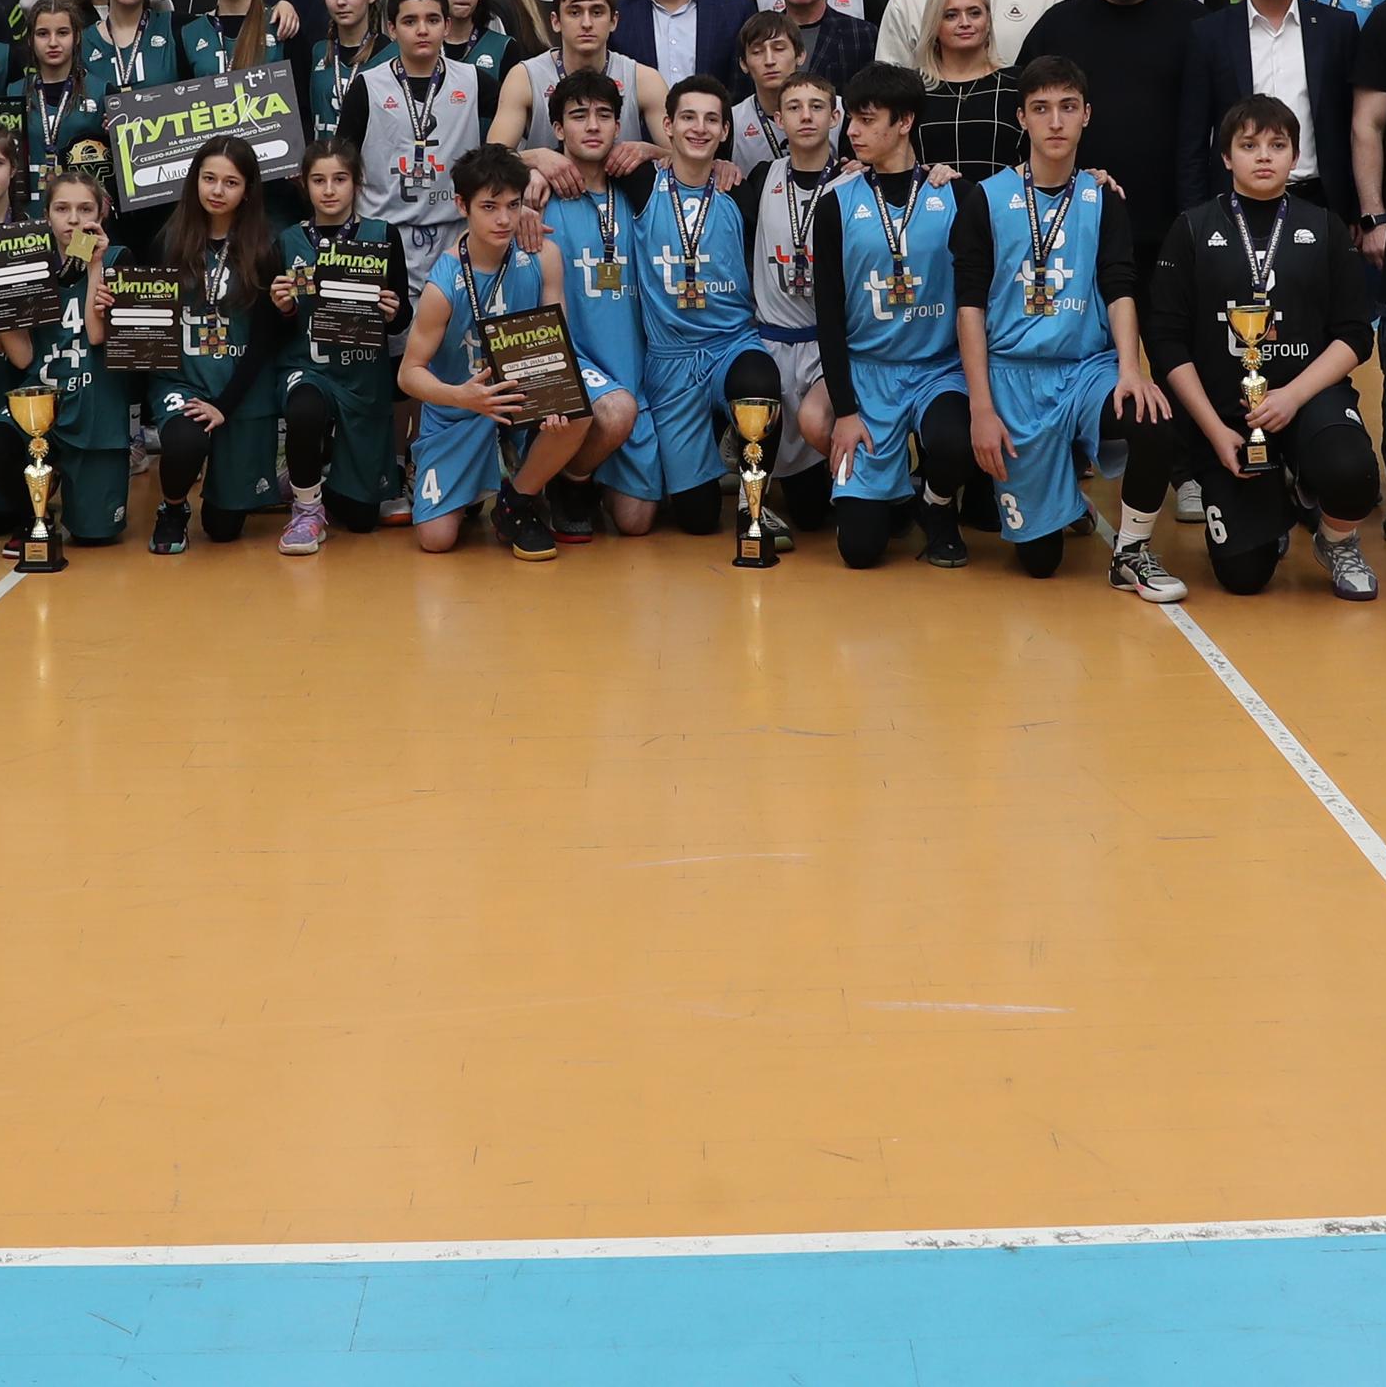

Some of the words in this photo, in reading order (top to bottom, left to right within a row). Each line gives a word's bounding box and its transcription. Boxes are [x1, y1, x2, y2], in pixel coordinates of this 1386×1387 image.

[115, 91, 292, 147] ПУТЁВКА
[178, 135, 201, 145] ФИНАЛ
[317, 243, 388, 270] ДИПЛОМ
[107, 271, 179, 297] ДИПЛОМ
[62, 297, 85, 334] 4
[903, 301, 946, 322] group
[490, 325, 564, 352] ДИПЛОМ
[1263, 340, 1310, 363] group
[164, 392, 187, 411] 3
[421, 468, 442, 505] 4
[1000, 493, 1023, 531] 3
[1206, 504, 1228, 545] 6
